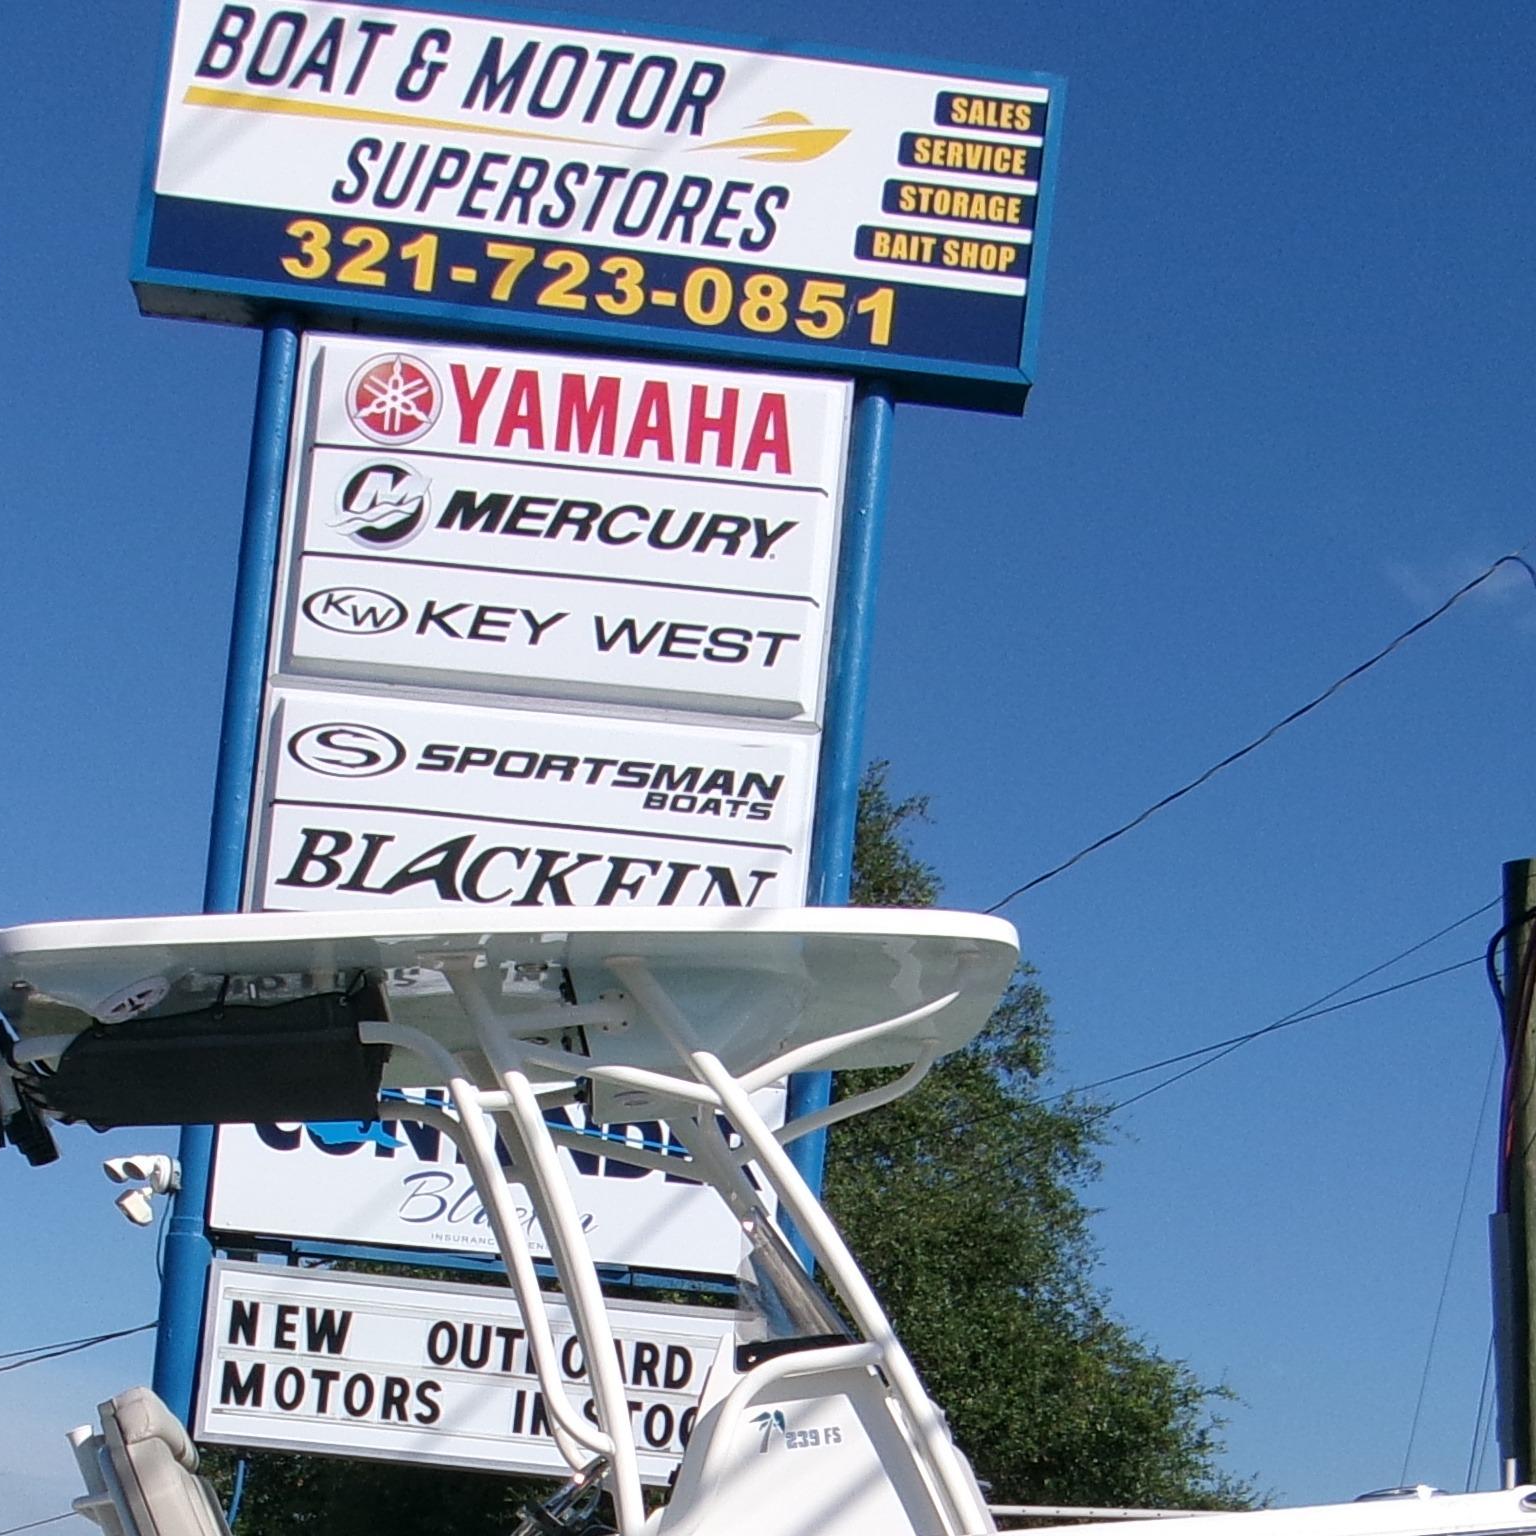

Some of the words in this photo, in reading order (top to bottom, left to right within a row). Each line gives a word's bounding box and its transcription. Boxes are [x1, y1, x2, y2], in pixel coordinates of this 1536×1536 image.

[195, 4, 396, 95] BOAT
[395, 29, 452, 102] &
[462, 37, 726, 136] MOTOR
[950, 97, 1031, 131] SALES
[914, 137, 1026, 175] SERVICE
[331, 137, 790, 252] SUPERSTORES
[899, 185, 1021, 224] STORAGE
[872, 230, 936, 263] BAIT
[942, 239, 1016, 272] SHOP
[281, 220, 896, 346] 321-723-0851
[449, 363, 791, 474] YAMAHA
[436, 489, 798, 559] MERCURY
[321, 592, 396, 632] KW
[415, 600, 570, 646] KEY
[593, 615, 800, 667] WEST
[415, 744, 784, 801] SPORTSMAN
[642, 792, 772, 821] BOATS
[275, 828, 776, 907] BLACKFIN
[431, 1233, 494, 1245] INSURANC
[228, 1300, 353, 1354] NEW
[220, 1360, 442, 1424] MOTORS
[785, 1428, 820, 1449] 239
[824, 1426, 842, 1445] FS
